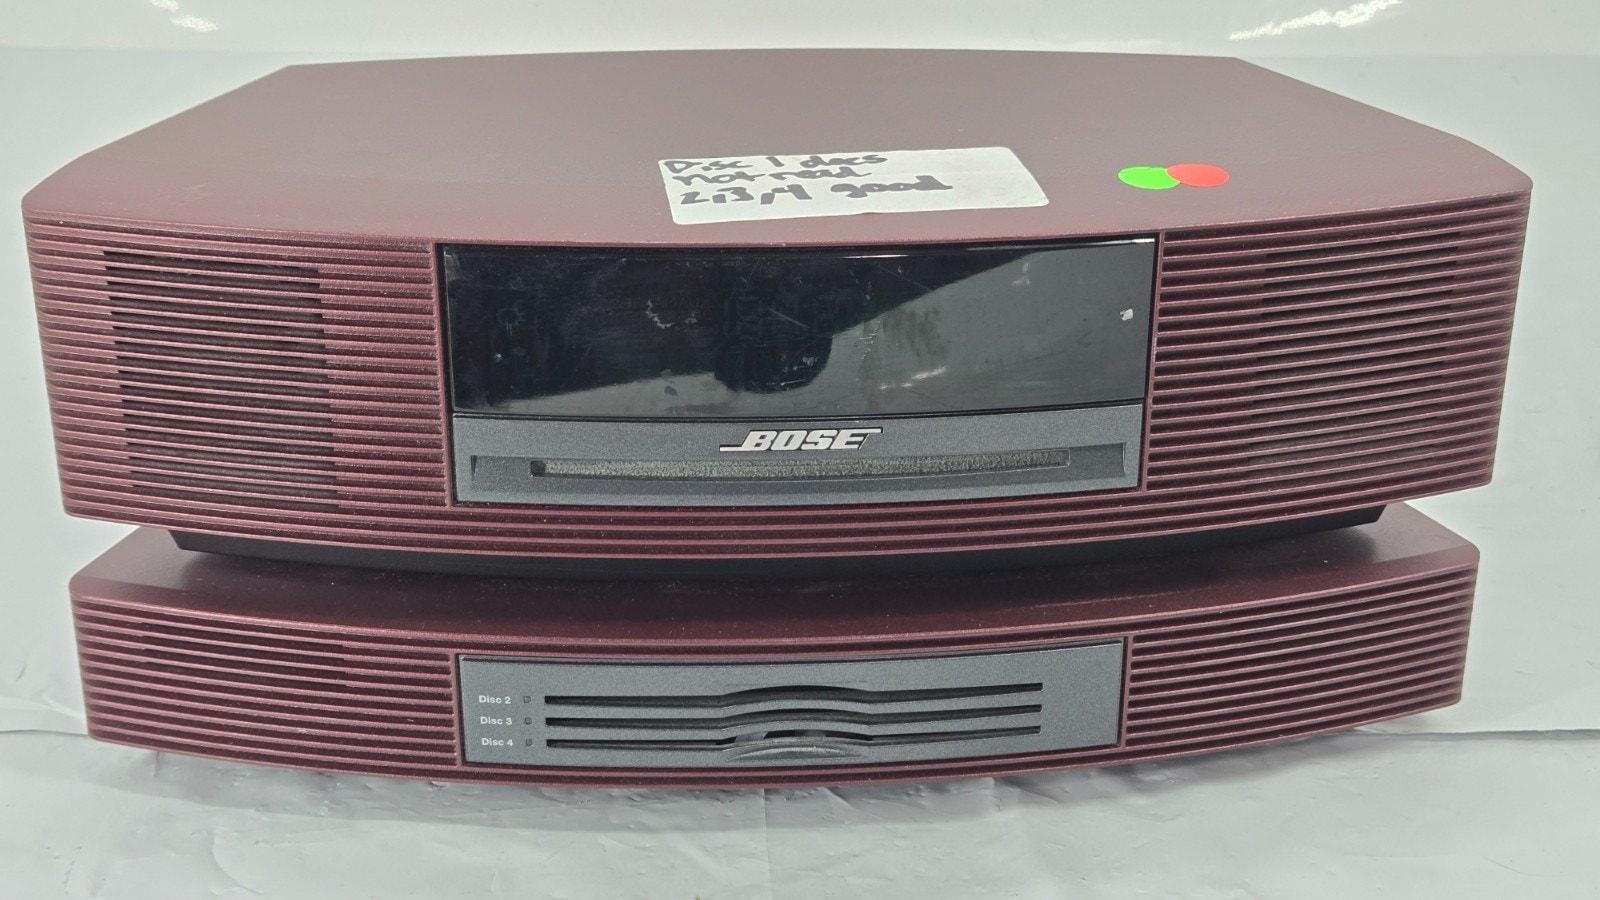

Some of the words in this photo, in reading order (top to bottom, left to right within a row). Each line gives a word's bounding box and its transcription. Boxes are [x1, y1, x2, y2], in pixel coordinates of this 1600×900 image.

[664, 160, 753, 174] Disc
[671, 171, 766, 186] not
[768, 166, 872, 181] read
[830, 175, 953, 199] good
[720, 427, 883, 452] BOSE
[479, 695, 502, 704] Disc
[504, 696, 511, 704] 2
[480, 716, 503, 725] Disc
[505, 717, 512, 725] 3
[481, 737, 504, 746] Disc
[506, 738, 513, 746] 4
